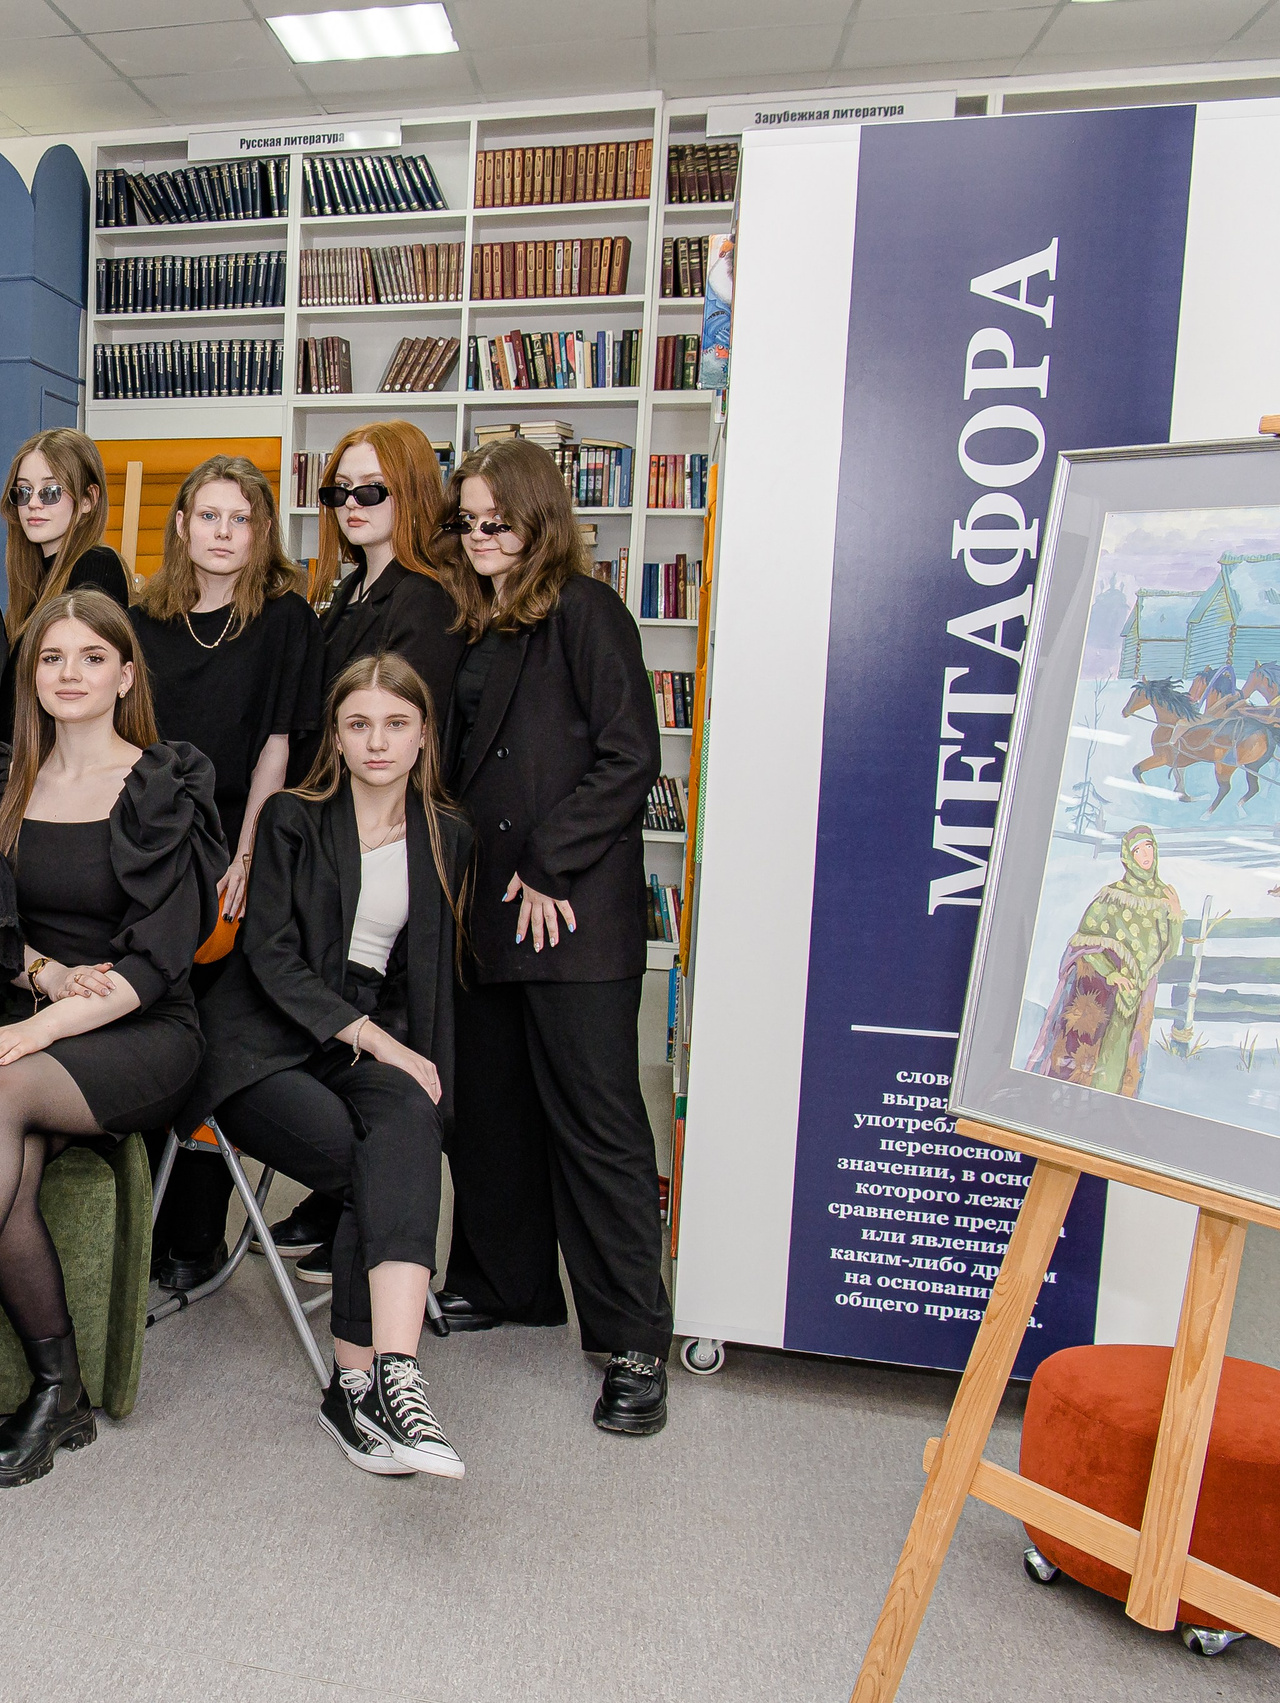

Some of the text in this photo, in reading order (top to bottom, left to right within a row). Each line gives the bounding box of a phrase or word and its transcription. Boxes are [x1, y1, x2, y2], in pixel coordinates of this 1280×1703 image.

[754, 104, 904, 125] Зарубежная литература
[240, 132, 345, 150] Русская литература
[896, 1066, 952, 1088] слов
[882, 1089, 949, 1111] выра
[854, 1110, 957, 1135] употребл
[880, 1137, 1022, 1164] переносном
[837, 1156, 1032, 1188] значении, в осно
[855, 1180, 1024, 1211] которого лежи
[828, 1199, 1066, 1239] сравнение преда
[861, 1227, 906, 1245] или
[829, 1244, 967, 1276] каким-либо
[844, 1270, 993, 1299] на основани
[835, 1291, 919, 1316] общего
